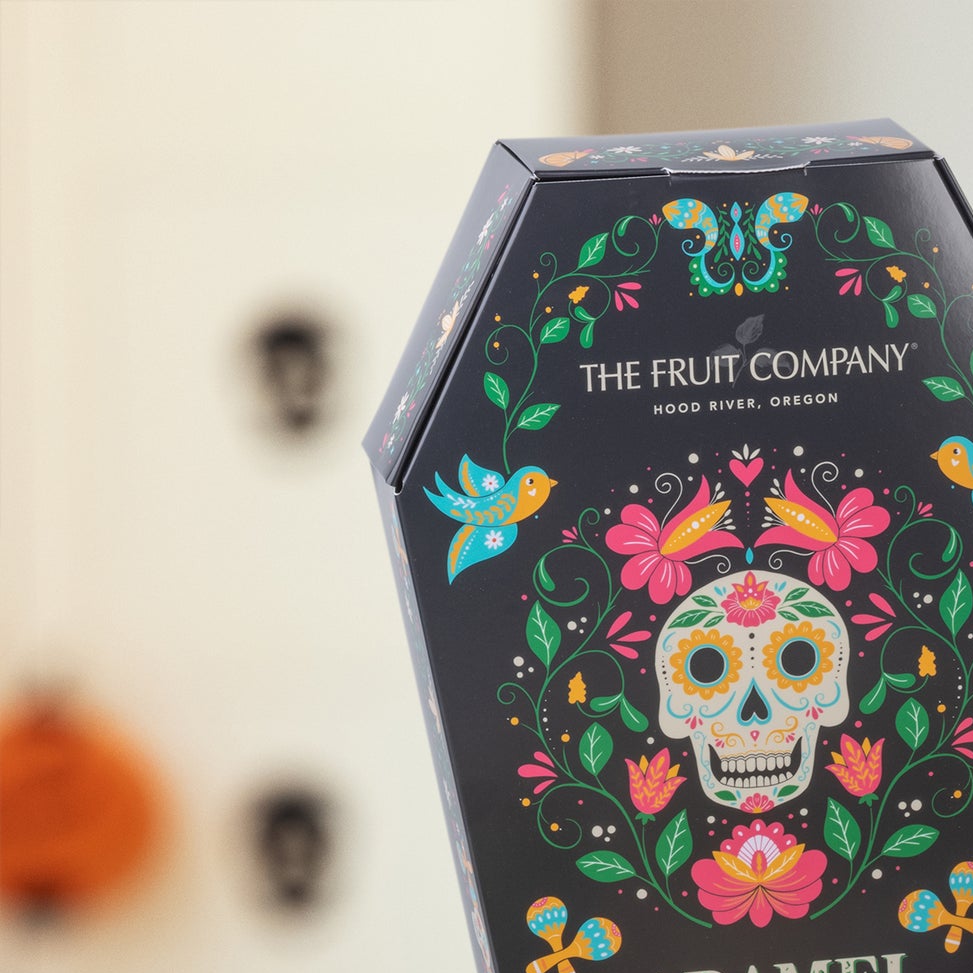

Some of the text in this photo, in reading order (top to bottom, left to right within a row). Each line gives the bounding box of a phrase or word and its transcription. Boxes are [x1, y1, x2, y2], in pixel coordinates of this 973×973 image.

[579, 361, 641, 393] THE
[651, 355, 740, 388] FRUIT
[653, 392, 839, 416] HOOD RIVER, OREGON
